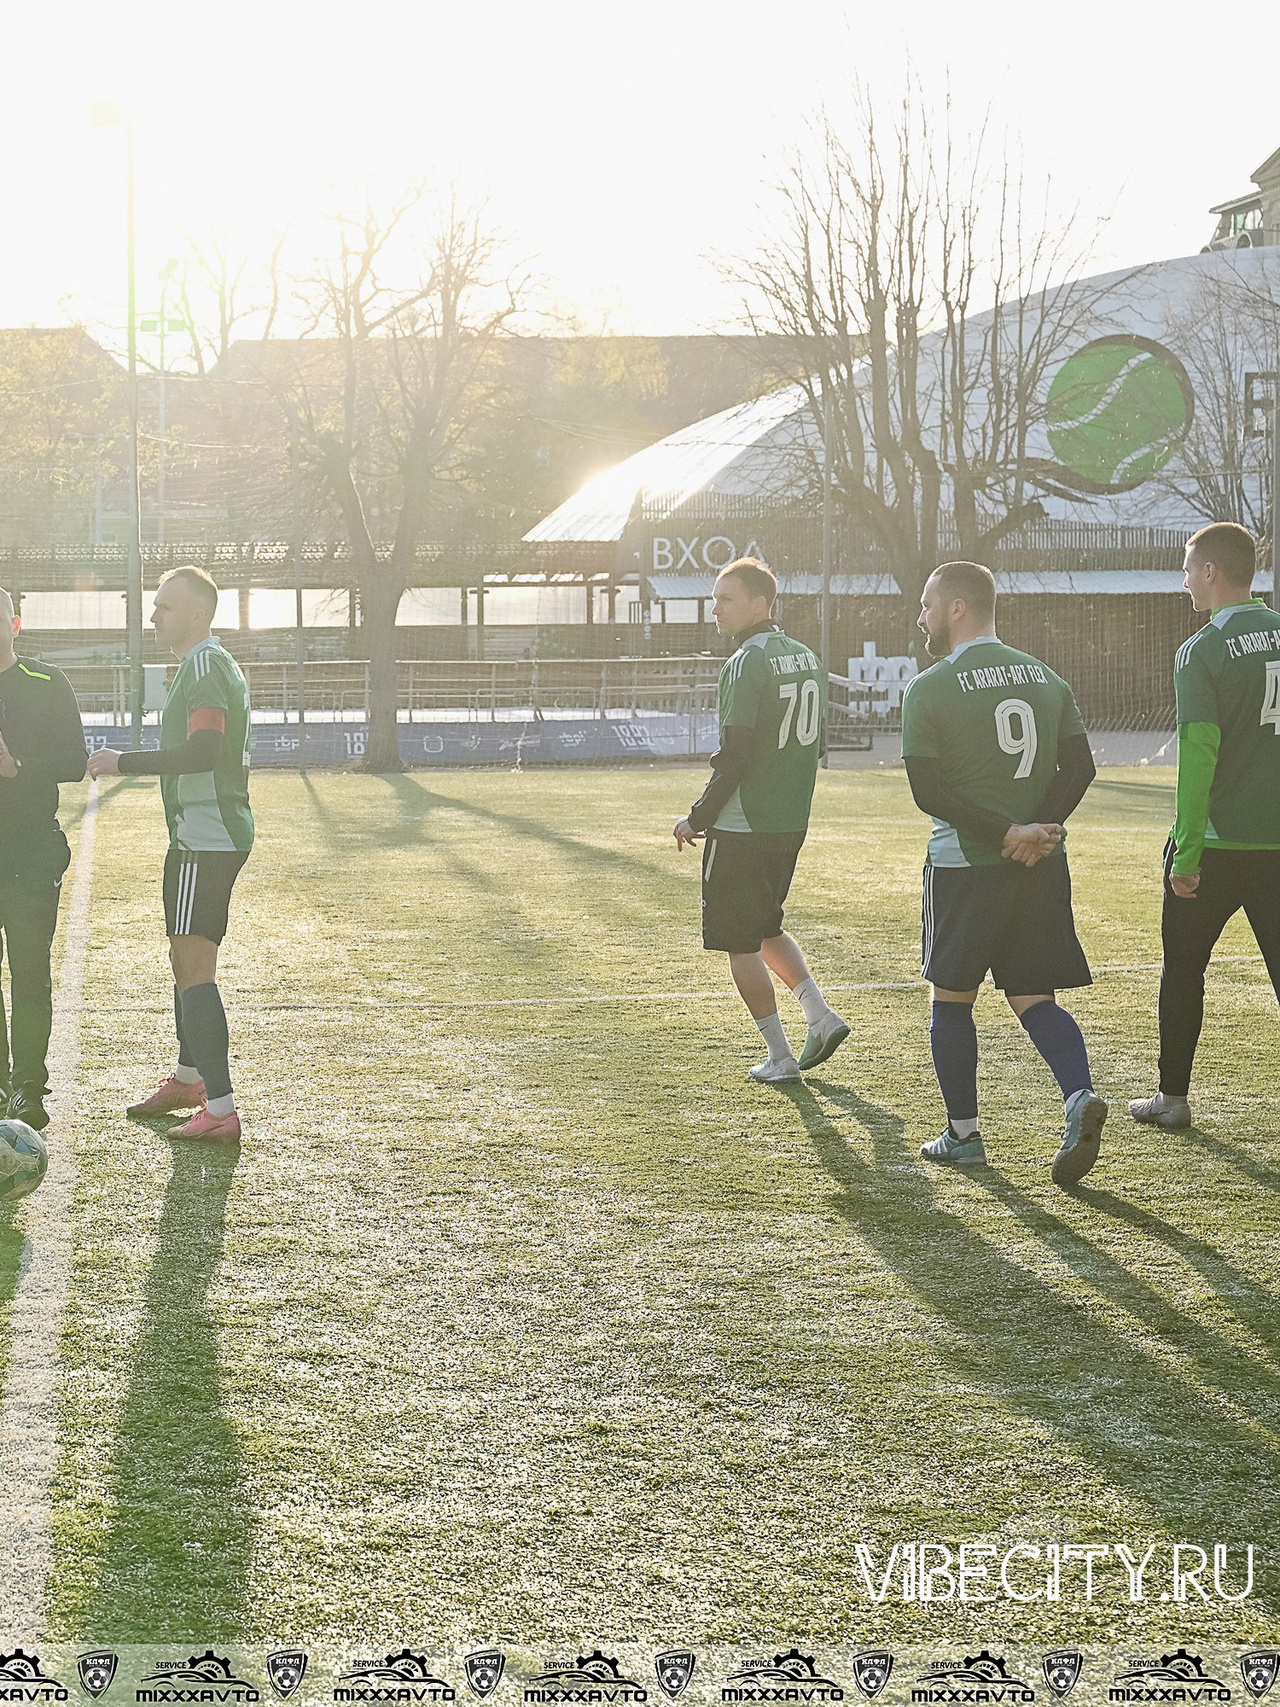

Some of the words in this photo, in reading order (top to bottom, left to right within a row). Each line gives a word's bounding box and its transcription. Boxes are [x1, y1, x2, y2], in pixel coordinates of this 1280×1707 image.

[1226, 637, 1241, 659] FC
[956, 671, 974, 693] FC
[971, 664, 1029, 689] ARARAT-ART
[778, 679, 820, 750] 70
[994, 698, 1038, 780] 9
